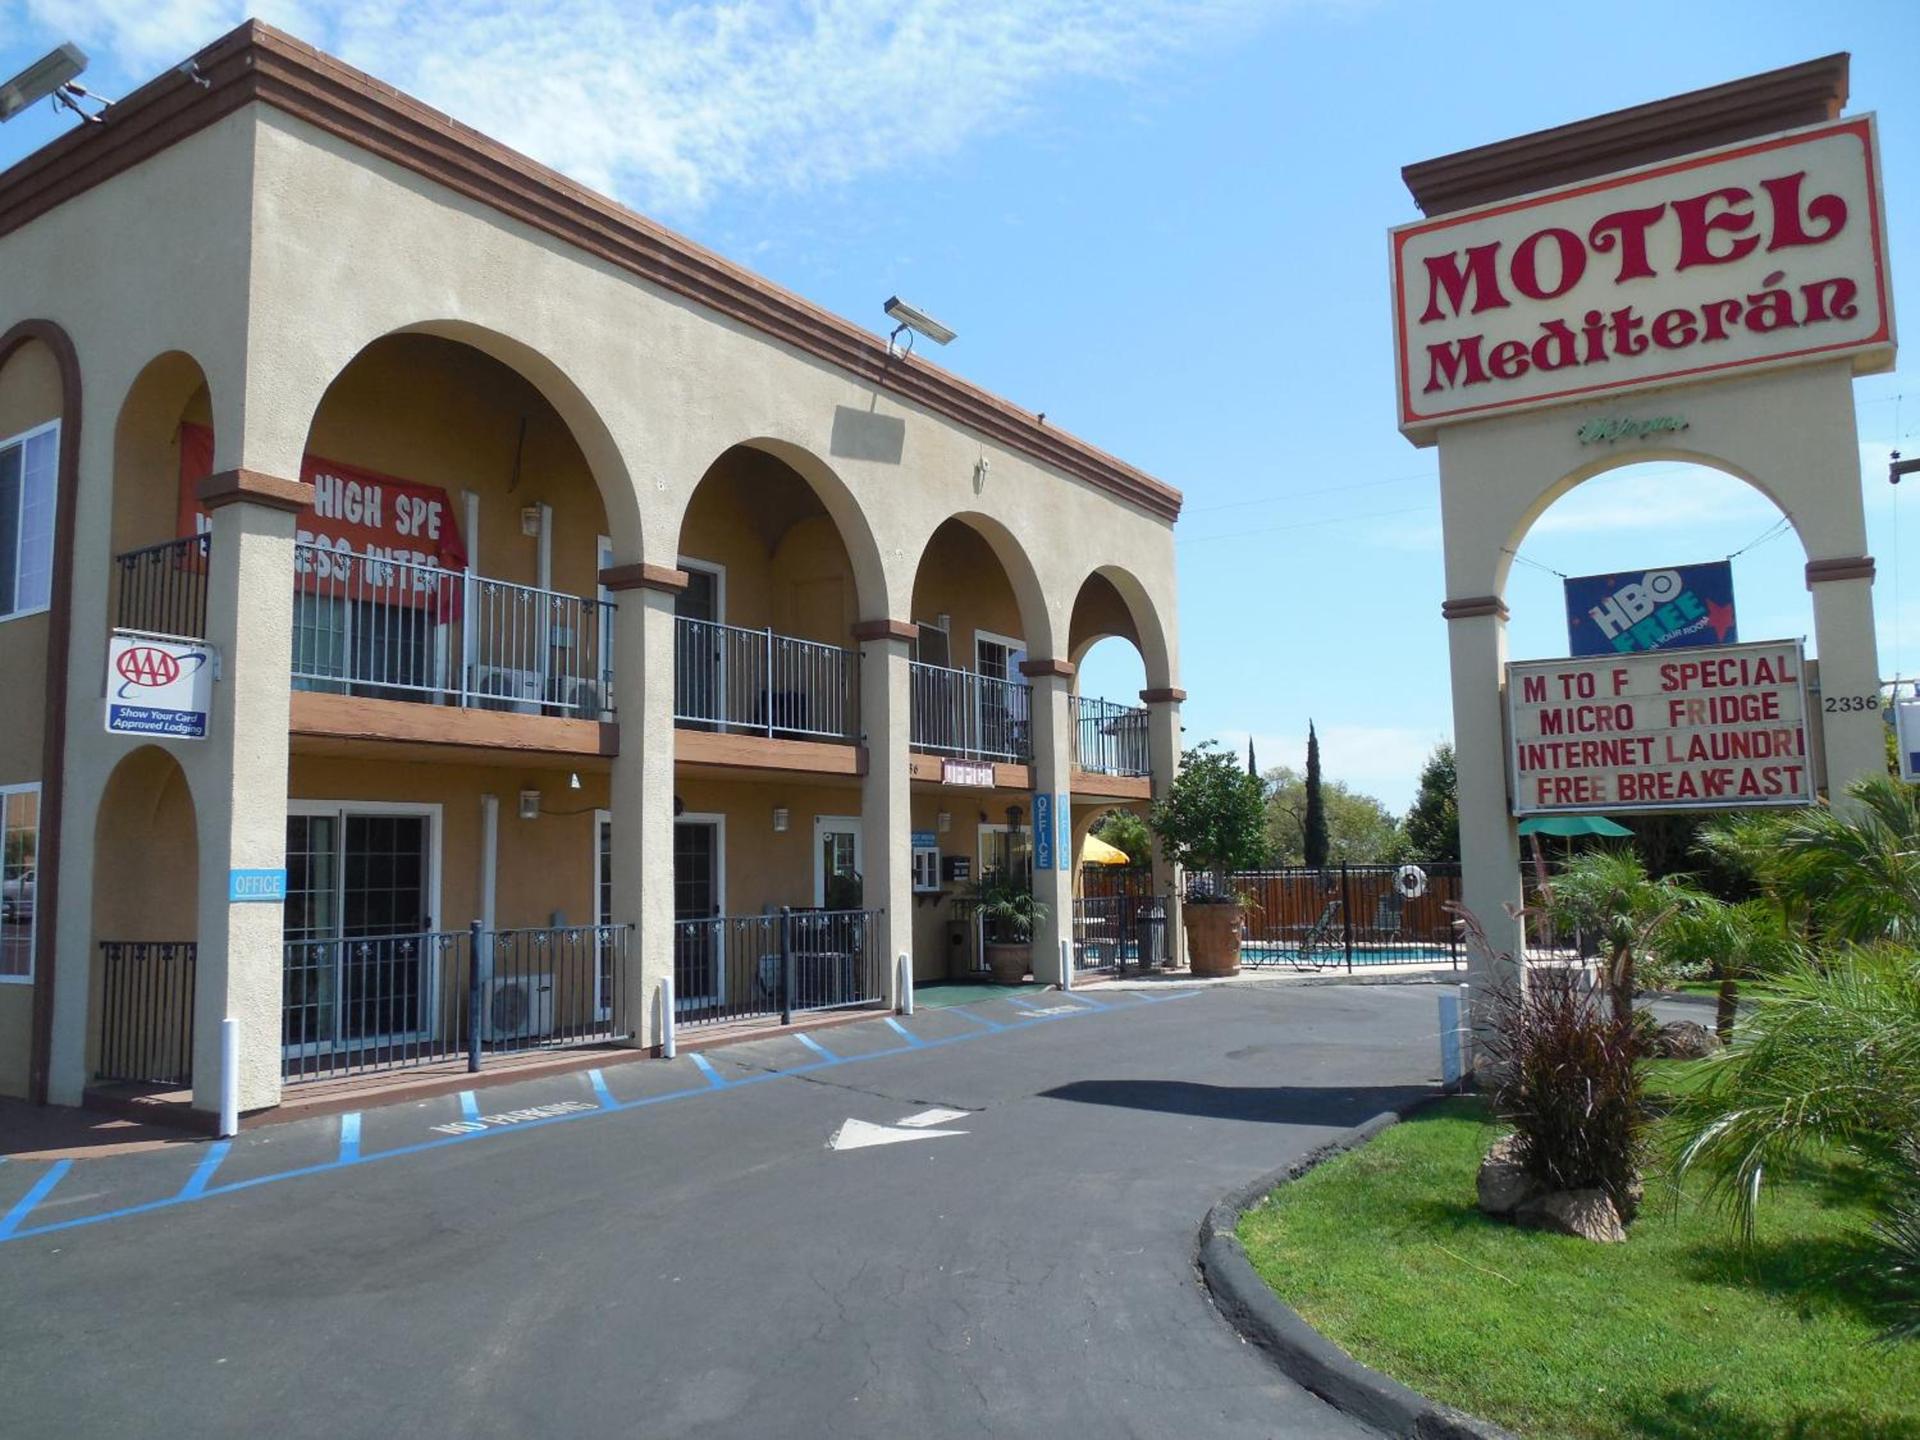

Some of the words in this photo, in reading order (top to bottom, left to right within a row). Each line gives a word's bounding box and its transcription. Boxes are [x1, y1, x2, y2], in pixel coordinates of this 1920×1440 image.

[1420, 172, 1848, 324] MOTEL
[1423, 270, 1858, 394] Mediterán
[314, 474, 382, 528] HIGH
[395, 493, 442, 540] SPE
[1588, 569, 1683, 640] HBO
[1611, 590, 1707, 652] FREE
[120, 648, 175, 686] AAA
[1524, 676, 1547, 702] M
[1558, 672, 1596, 699] TO
[1613, 669, 1629, 696] F
[1660, 655, 1798, 692] SPECIAL
[113, 718, 162, 731] Approved
[164, 722, 202, 734] Lodging
[120, 708, 149, 718] Show
[151, 711, 173, 720] Your
[175, 712, 198, 722] Card
[1540, 703, 1634, 735] MICRO
[1669, 691, 1779, 727] FRIDGE
[1825, 695, 1878, 713] 2336
[1519, 737, 1655, 771] INTERNET
[1537, 775, 1605, 804] FREE
[1617, 765, 1803, 801] BREAKFAST
[1037, 796, 1048, 867] OFFICE
[235, 875, 281, 893] OFFICE
